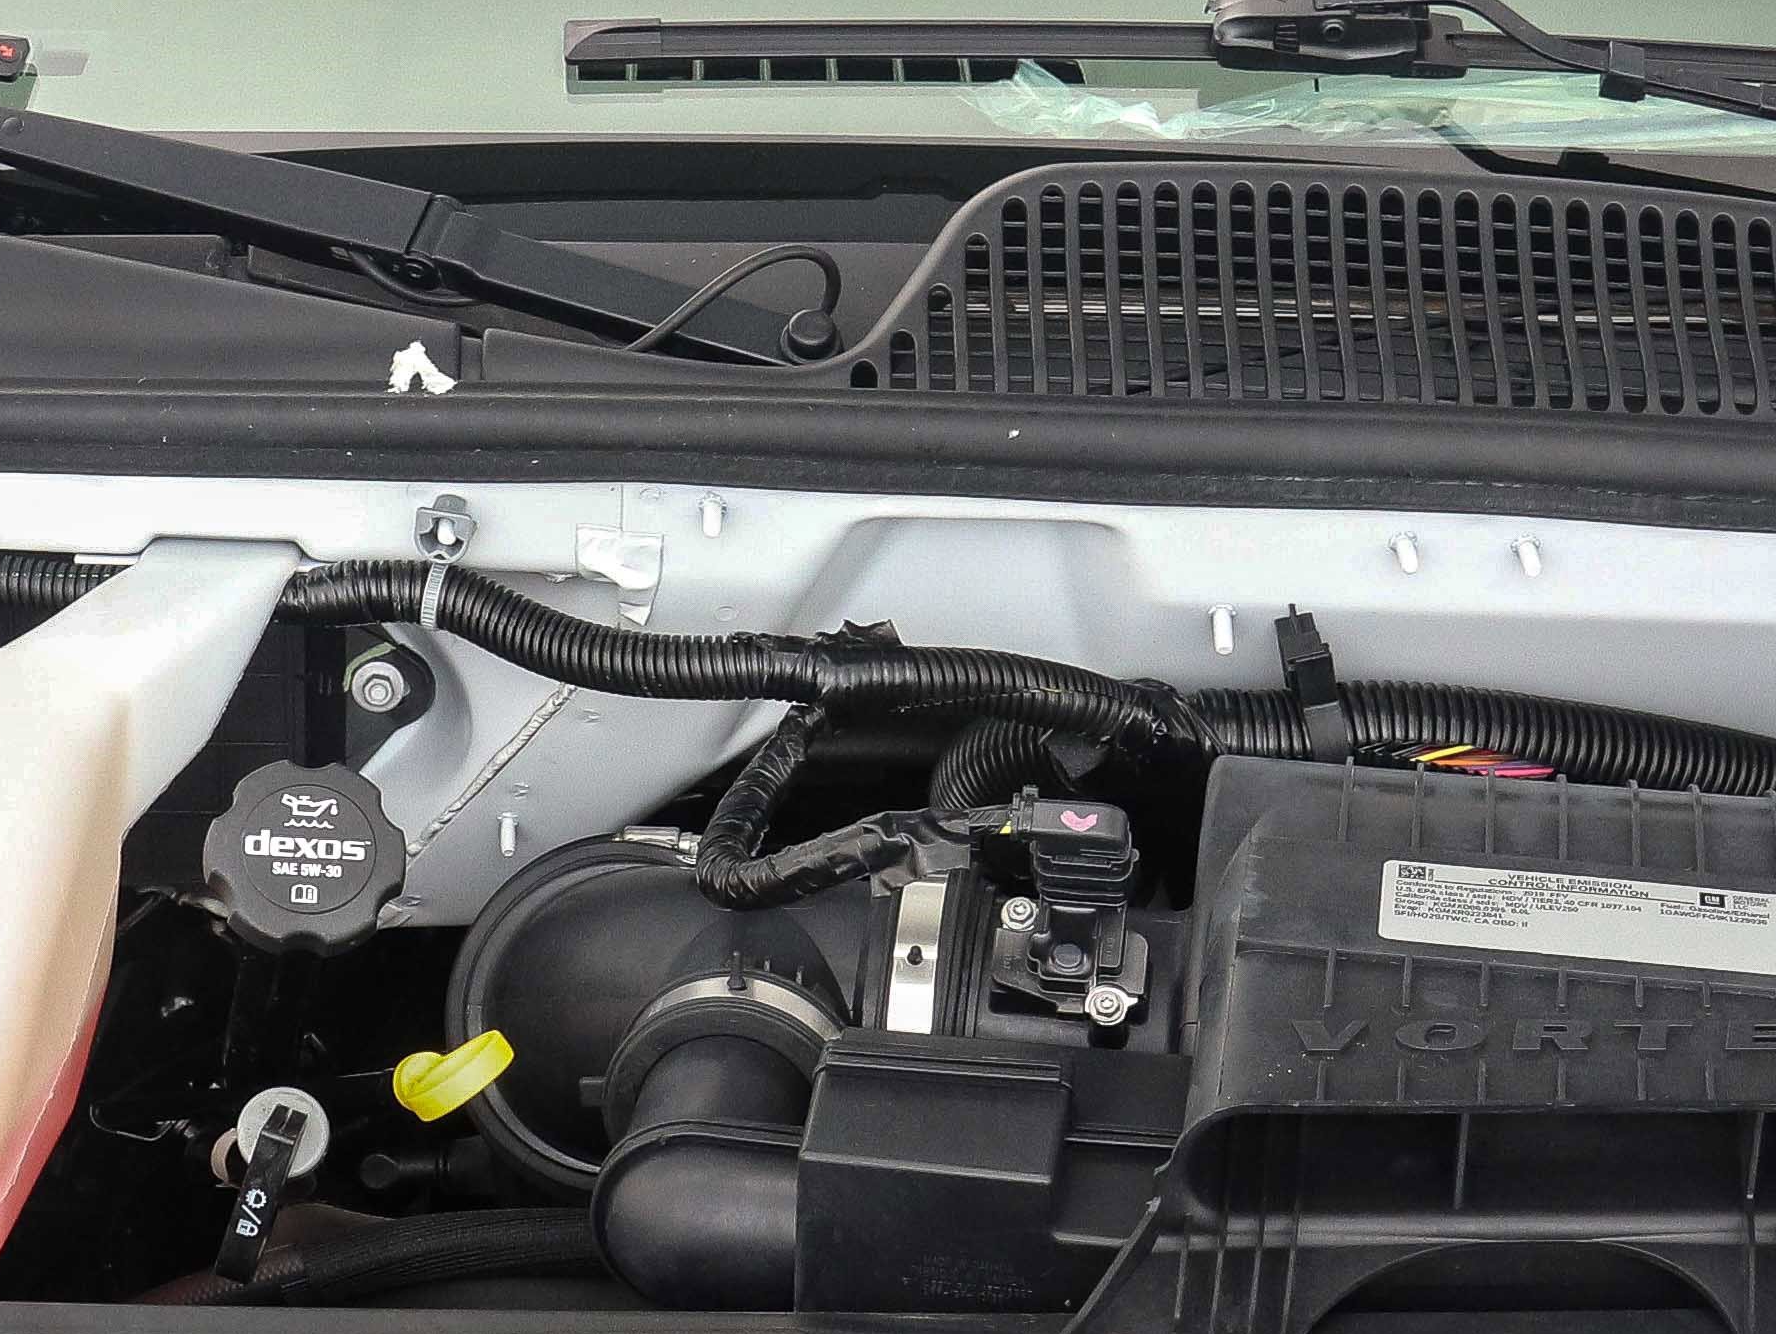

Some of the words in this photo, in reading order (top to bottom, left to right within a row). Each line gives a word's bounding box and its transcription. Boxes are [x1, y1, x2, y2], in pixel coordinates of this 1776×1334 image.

[272, 861, 298, 875] SAE
[300, 863, 342, 878] 5W-30
[1396, 879, 1442, 888] Conforms
[1488, 878, 1550, 889] CONTROL
[1556, 883, 1648, 897] INFORMATION
[1508, 873, 1563, 883] VEHICLE
[1568, 879, 1632, 889] EMISSION
